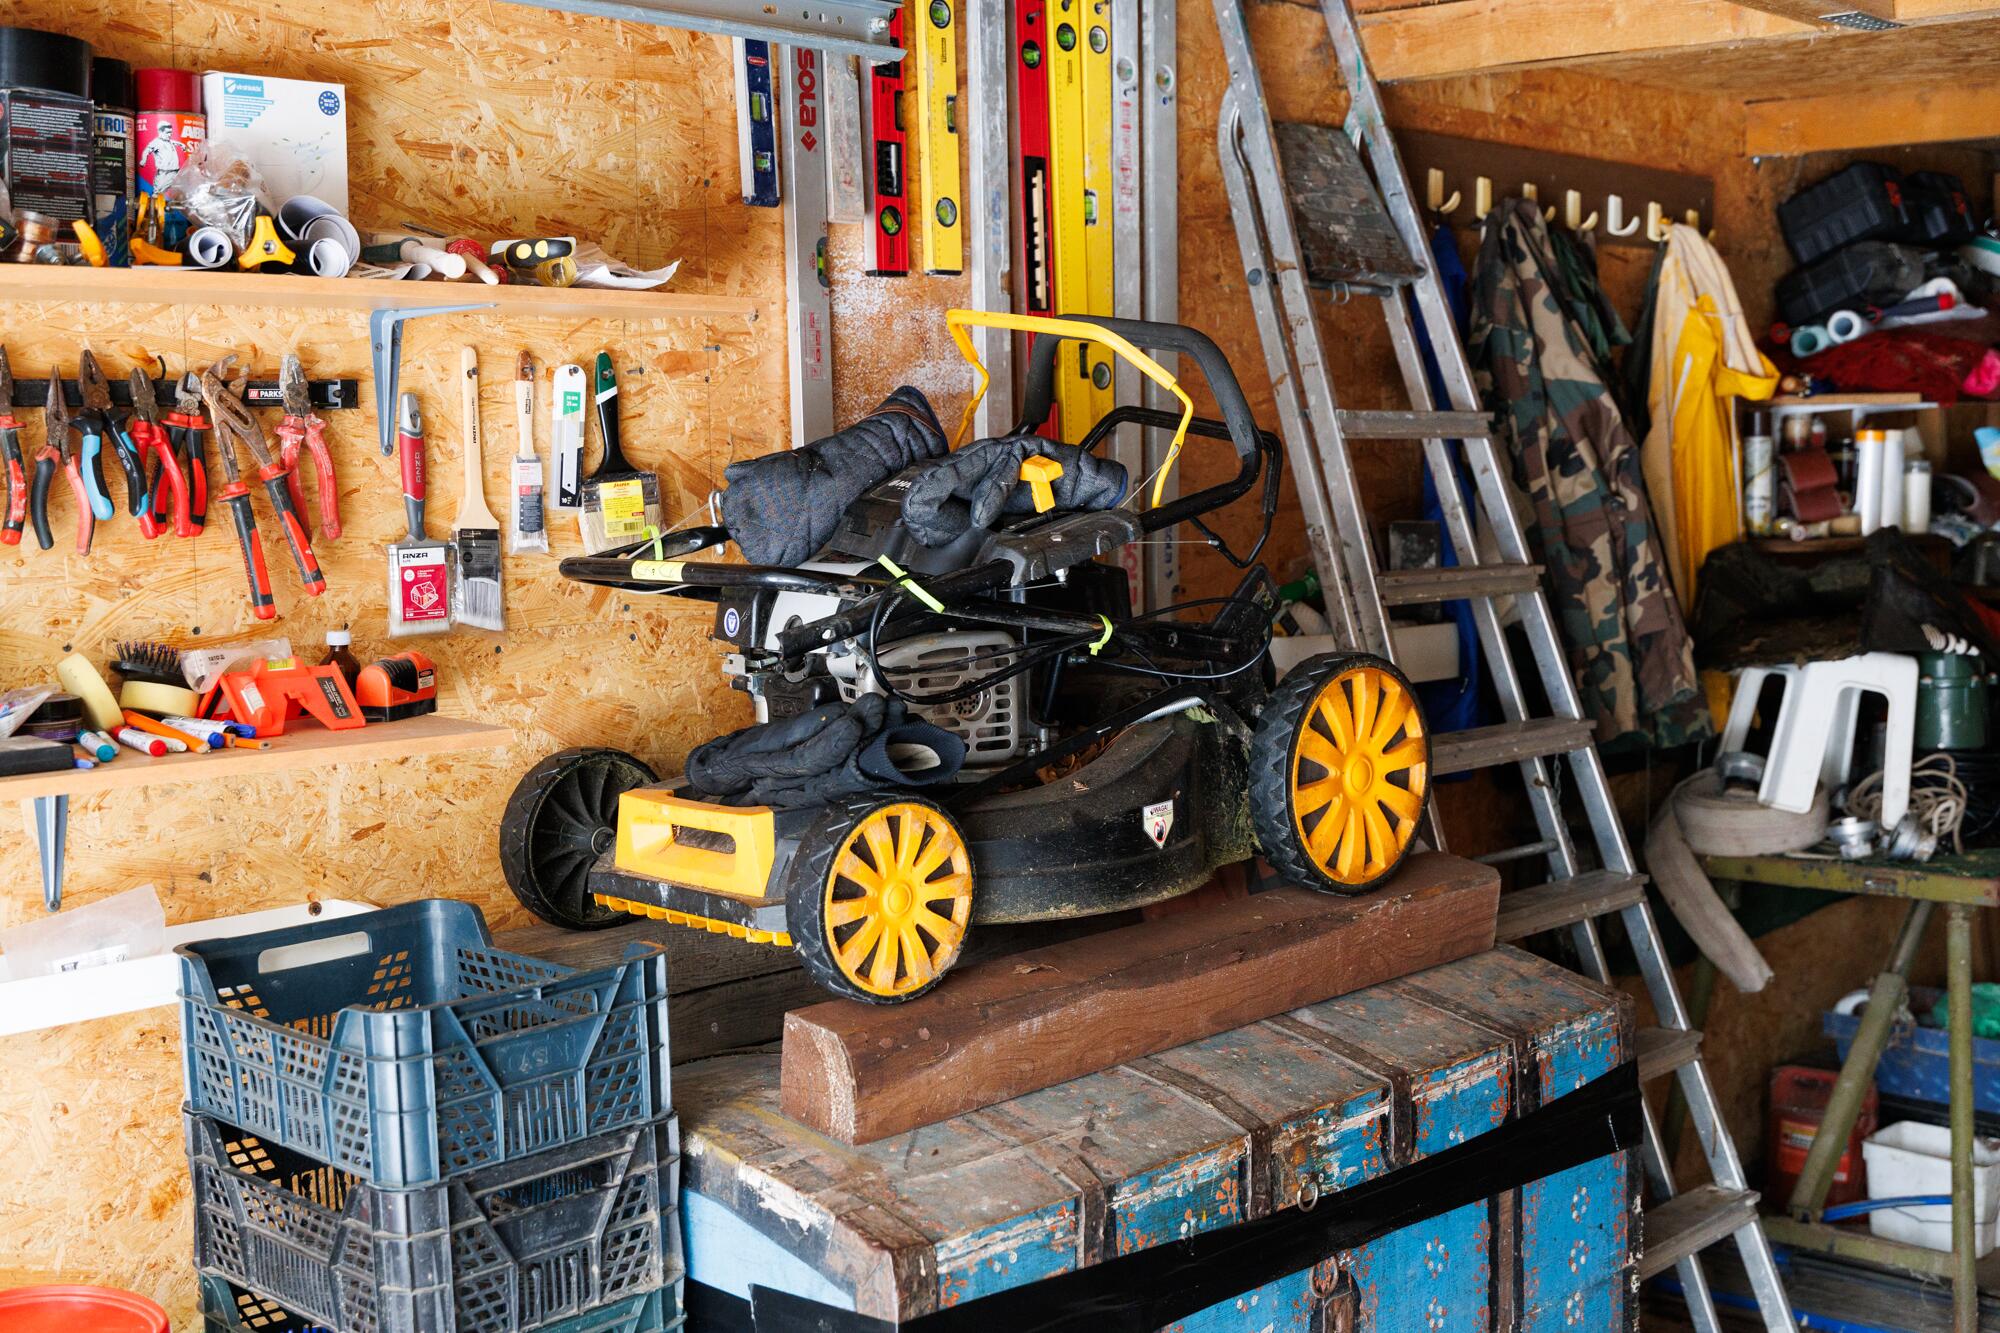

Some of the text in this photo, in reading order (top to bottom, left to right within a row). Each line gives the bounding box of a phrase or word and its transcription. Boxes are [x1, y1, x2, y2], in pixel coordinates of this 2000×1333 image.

[97, 116, 127, 134] TROL
[98, 137, 124, 149] Brilliant
[259, 389, 284, 399] PARKS
[414, 452, 422, 483] ANZA
[402, 552, 428, 560] ANZA
